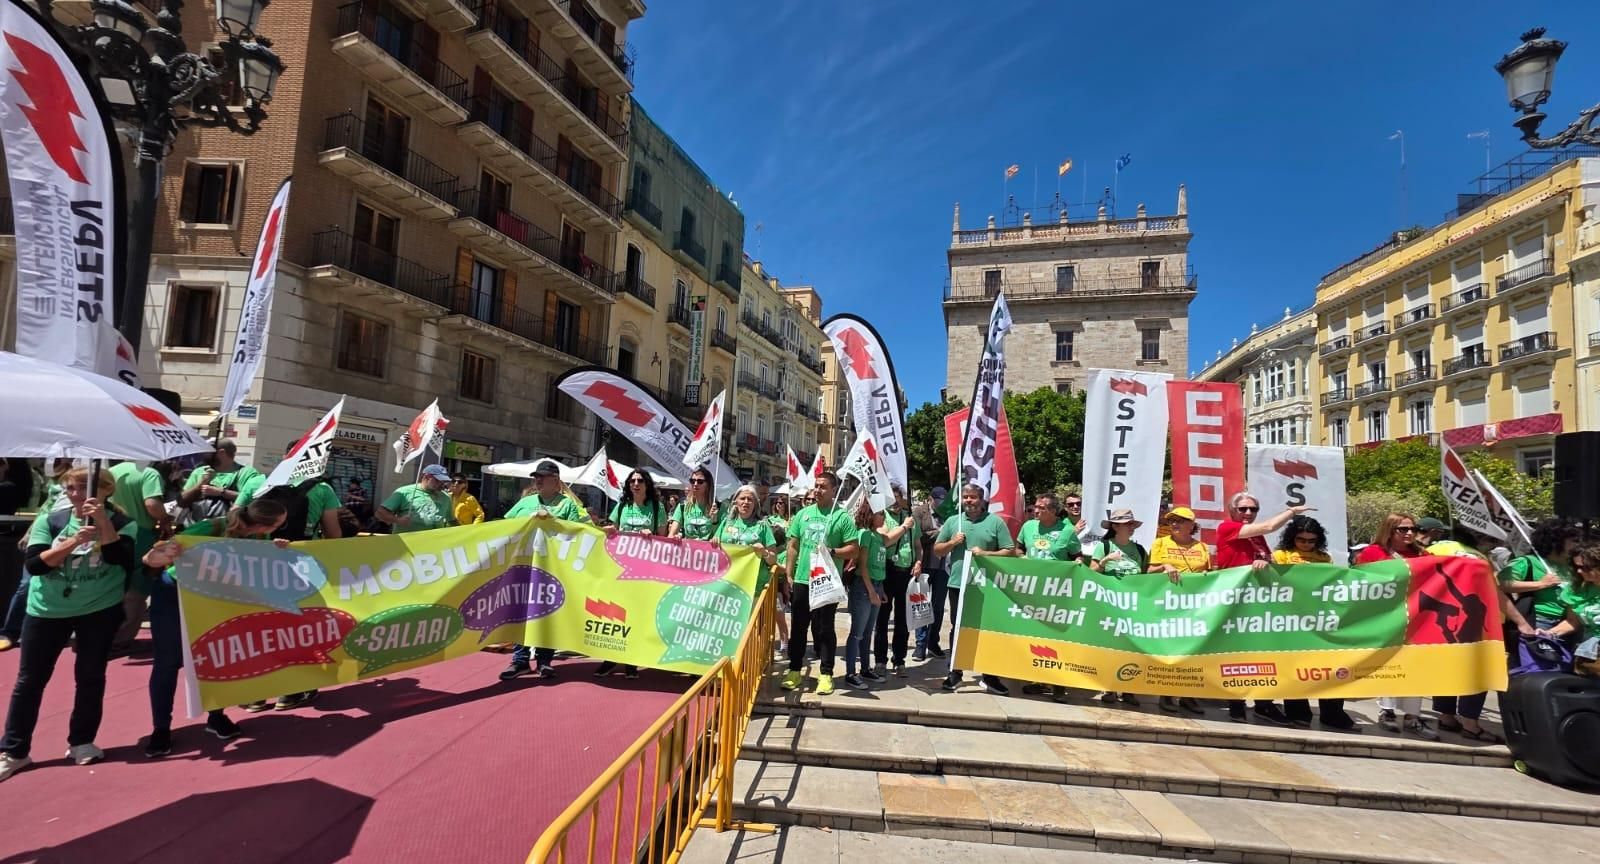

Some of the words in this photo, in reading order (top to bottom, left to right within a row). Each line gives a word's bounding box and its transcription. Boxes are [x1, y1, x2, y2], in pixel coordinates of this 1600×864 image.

[152, 428, 193, 444] STEPV
[335, 429, 376, 442] ELADERIA
[182, 546, 310, 591] -RÀTIOS
[466, 583, 556, 620] +PLANTILLES
[683, 585, 741, 617] CENTRES
[993, 571, 1038, 595] N'HI
[1042, 577, 1073, 598] HA
[1080, 579, 1138, 611] PROU!
[1154, 583, 1294, 611] -burocràcia
[1311, 579, 1397, 602] -ràtios
[355, 617, 451, 652] +SALARI
[584, 619, 631, 638] STEPV
[669, 603, 741, 640] EDUCATIUS
[1008, 603, 1086, 627] +salari
[1100, 617, 1208, 638] +plantilla
[1222, 610, 1340, 634] +valencià
[193, 614, 341, 669] +VALENCIÀ
[674, 625, 723, 657] DIGNES
[1032, 658, 1063, 670] STEPV
[1147, 665, 1175, 673] Central
[1147, 672, 1198, 681] Independiente
[1296, 668, 1332, 682] UGT
[1222, 677, 1278, 687] educació
